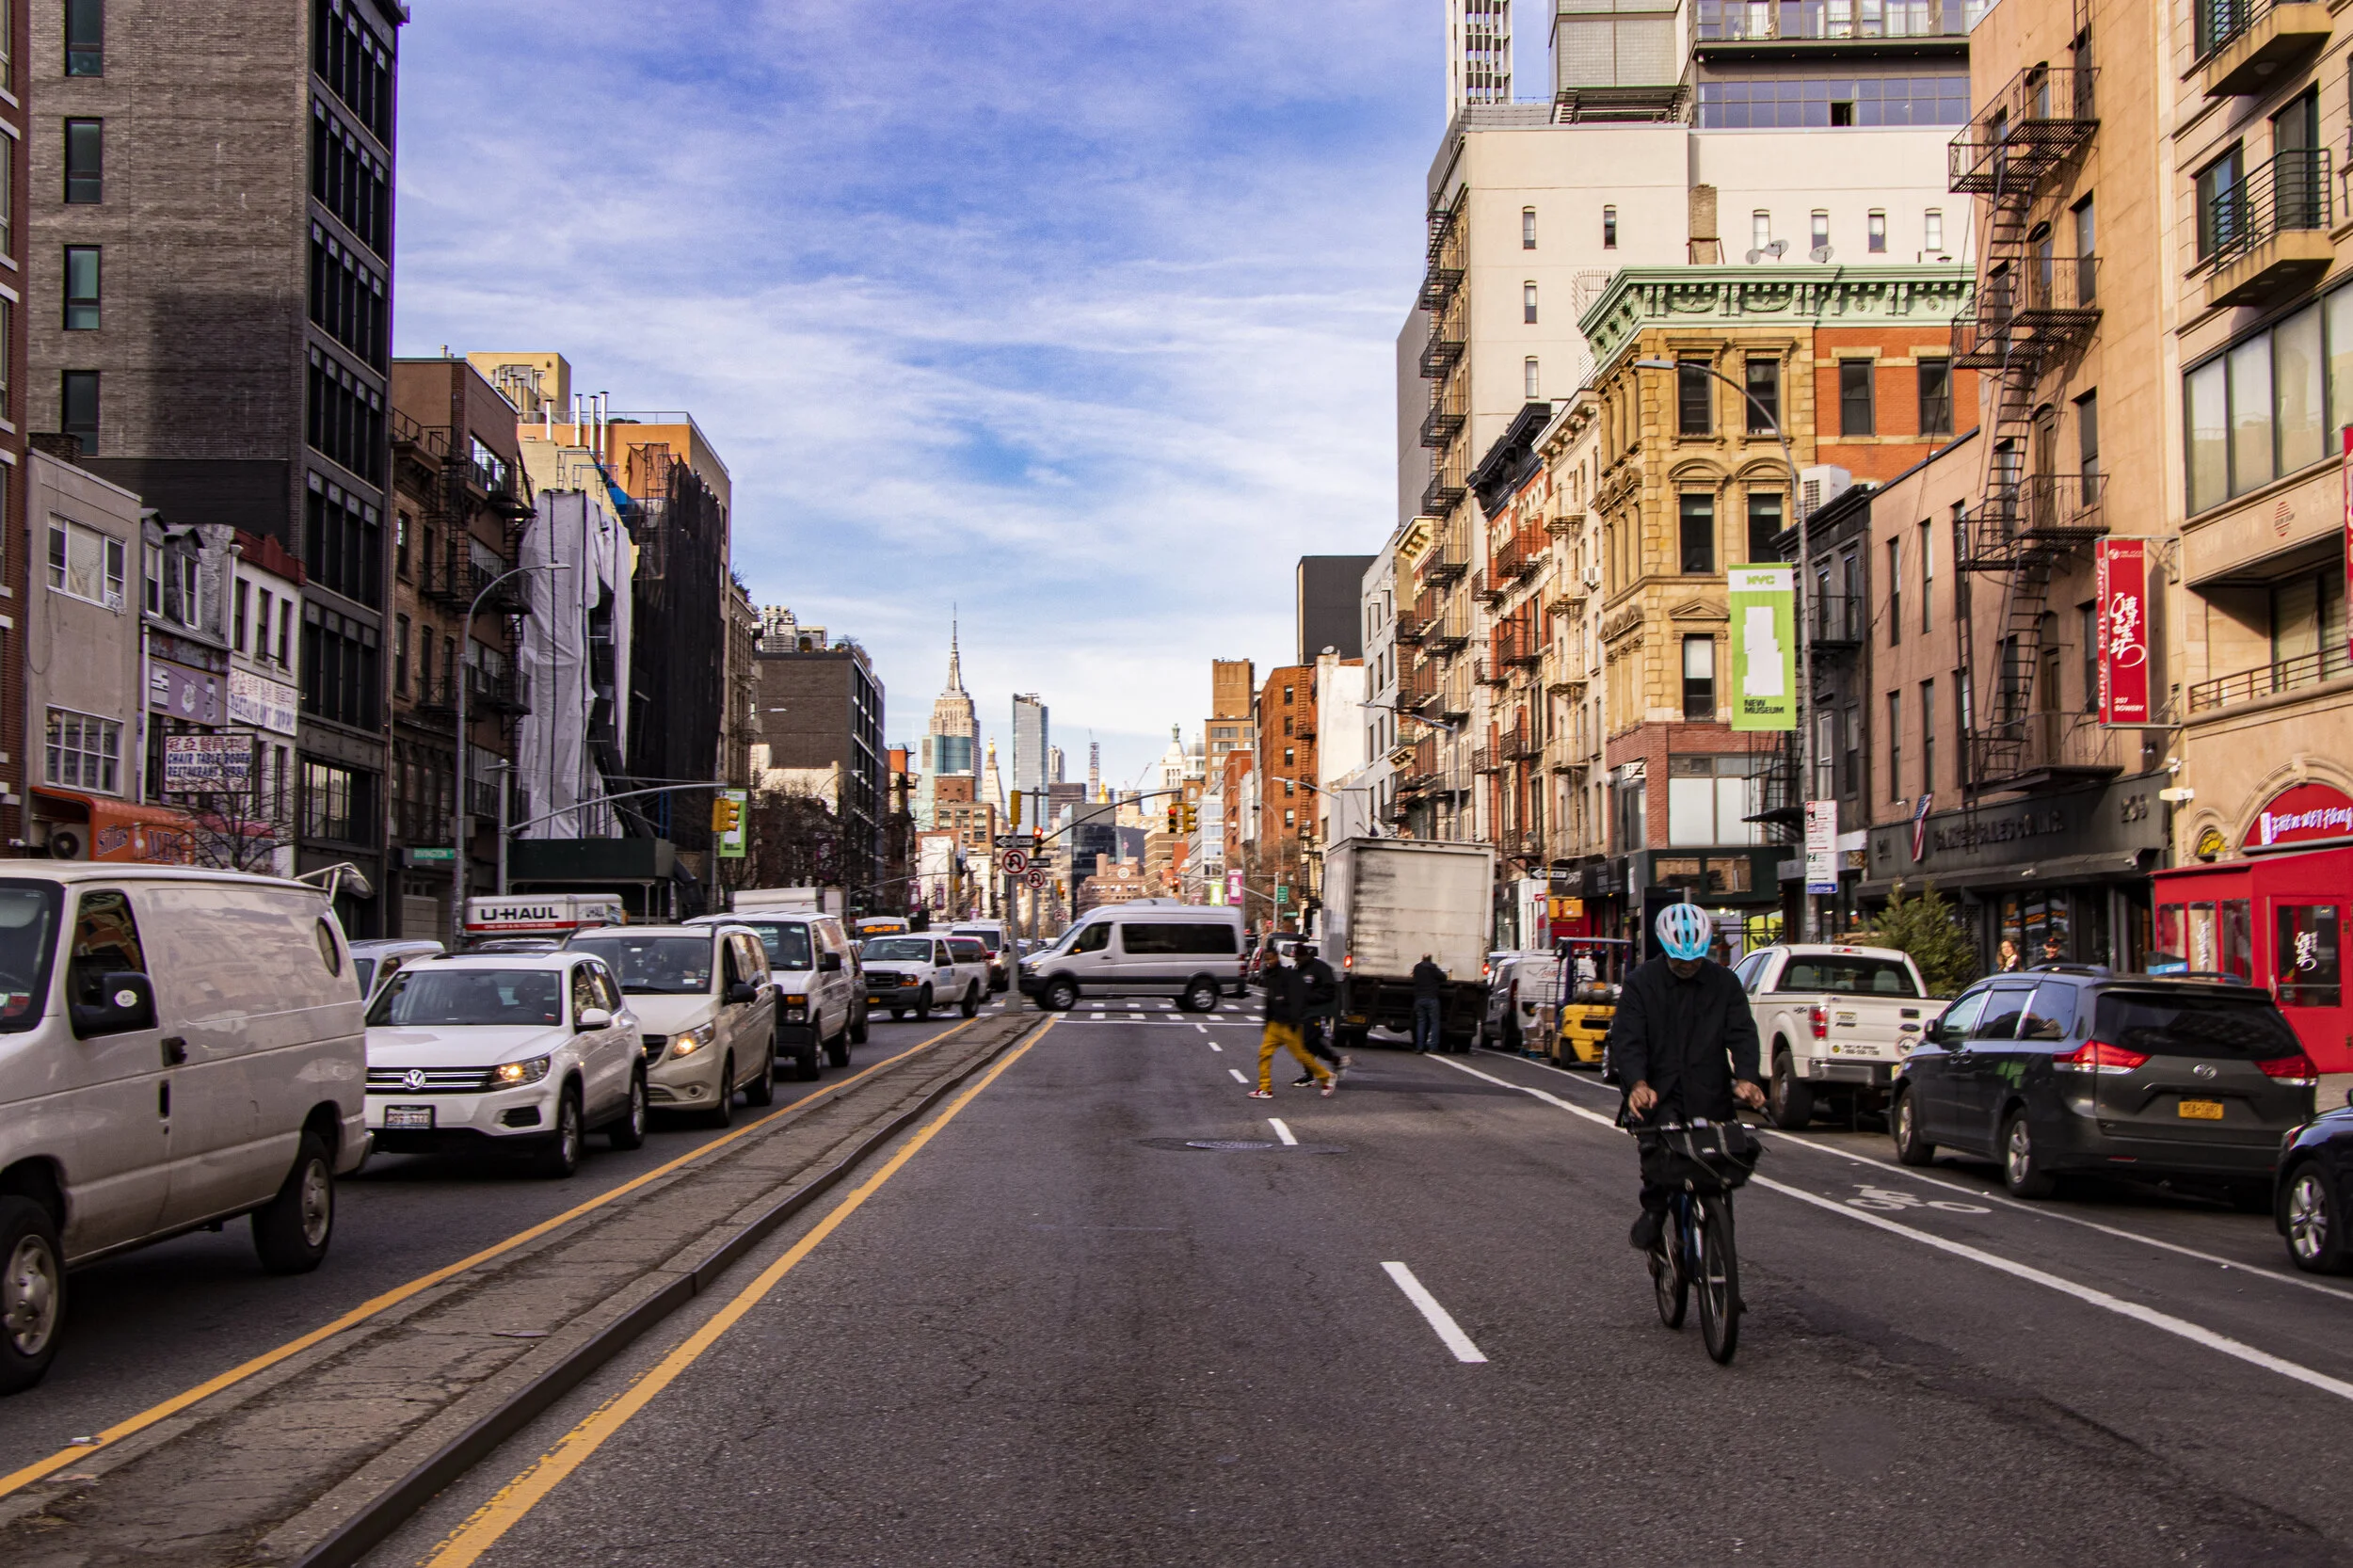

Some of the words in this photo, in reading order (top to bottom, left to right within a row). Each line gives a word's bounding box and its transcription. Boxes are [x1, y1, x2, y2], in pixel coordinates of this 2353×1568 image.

[1746, 575, 1776, 585] NYC
[1744, 706, 1785, 715] MUSEUM
[2114, 704, 2144, 712] BOWERY
[168, 753, 193, 764] CHAIR
[480, 906, 559, 920] U-HAUL
